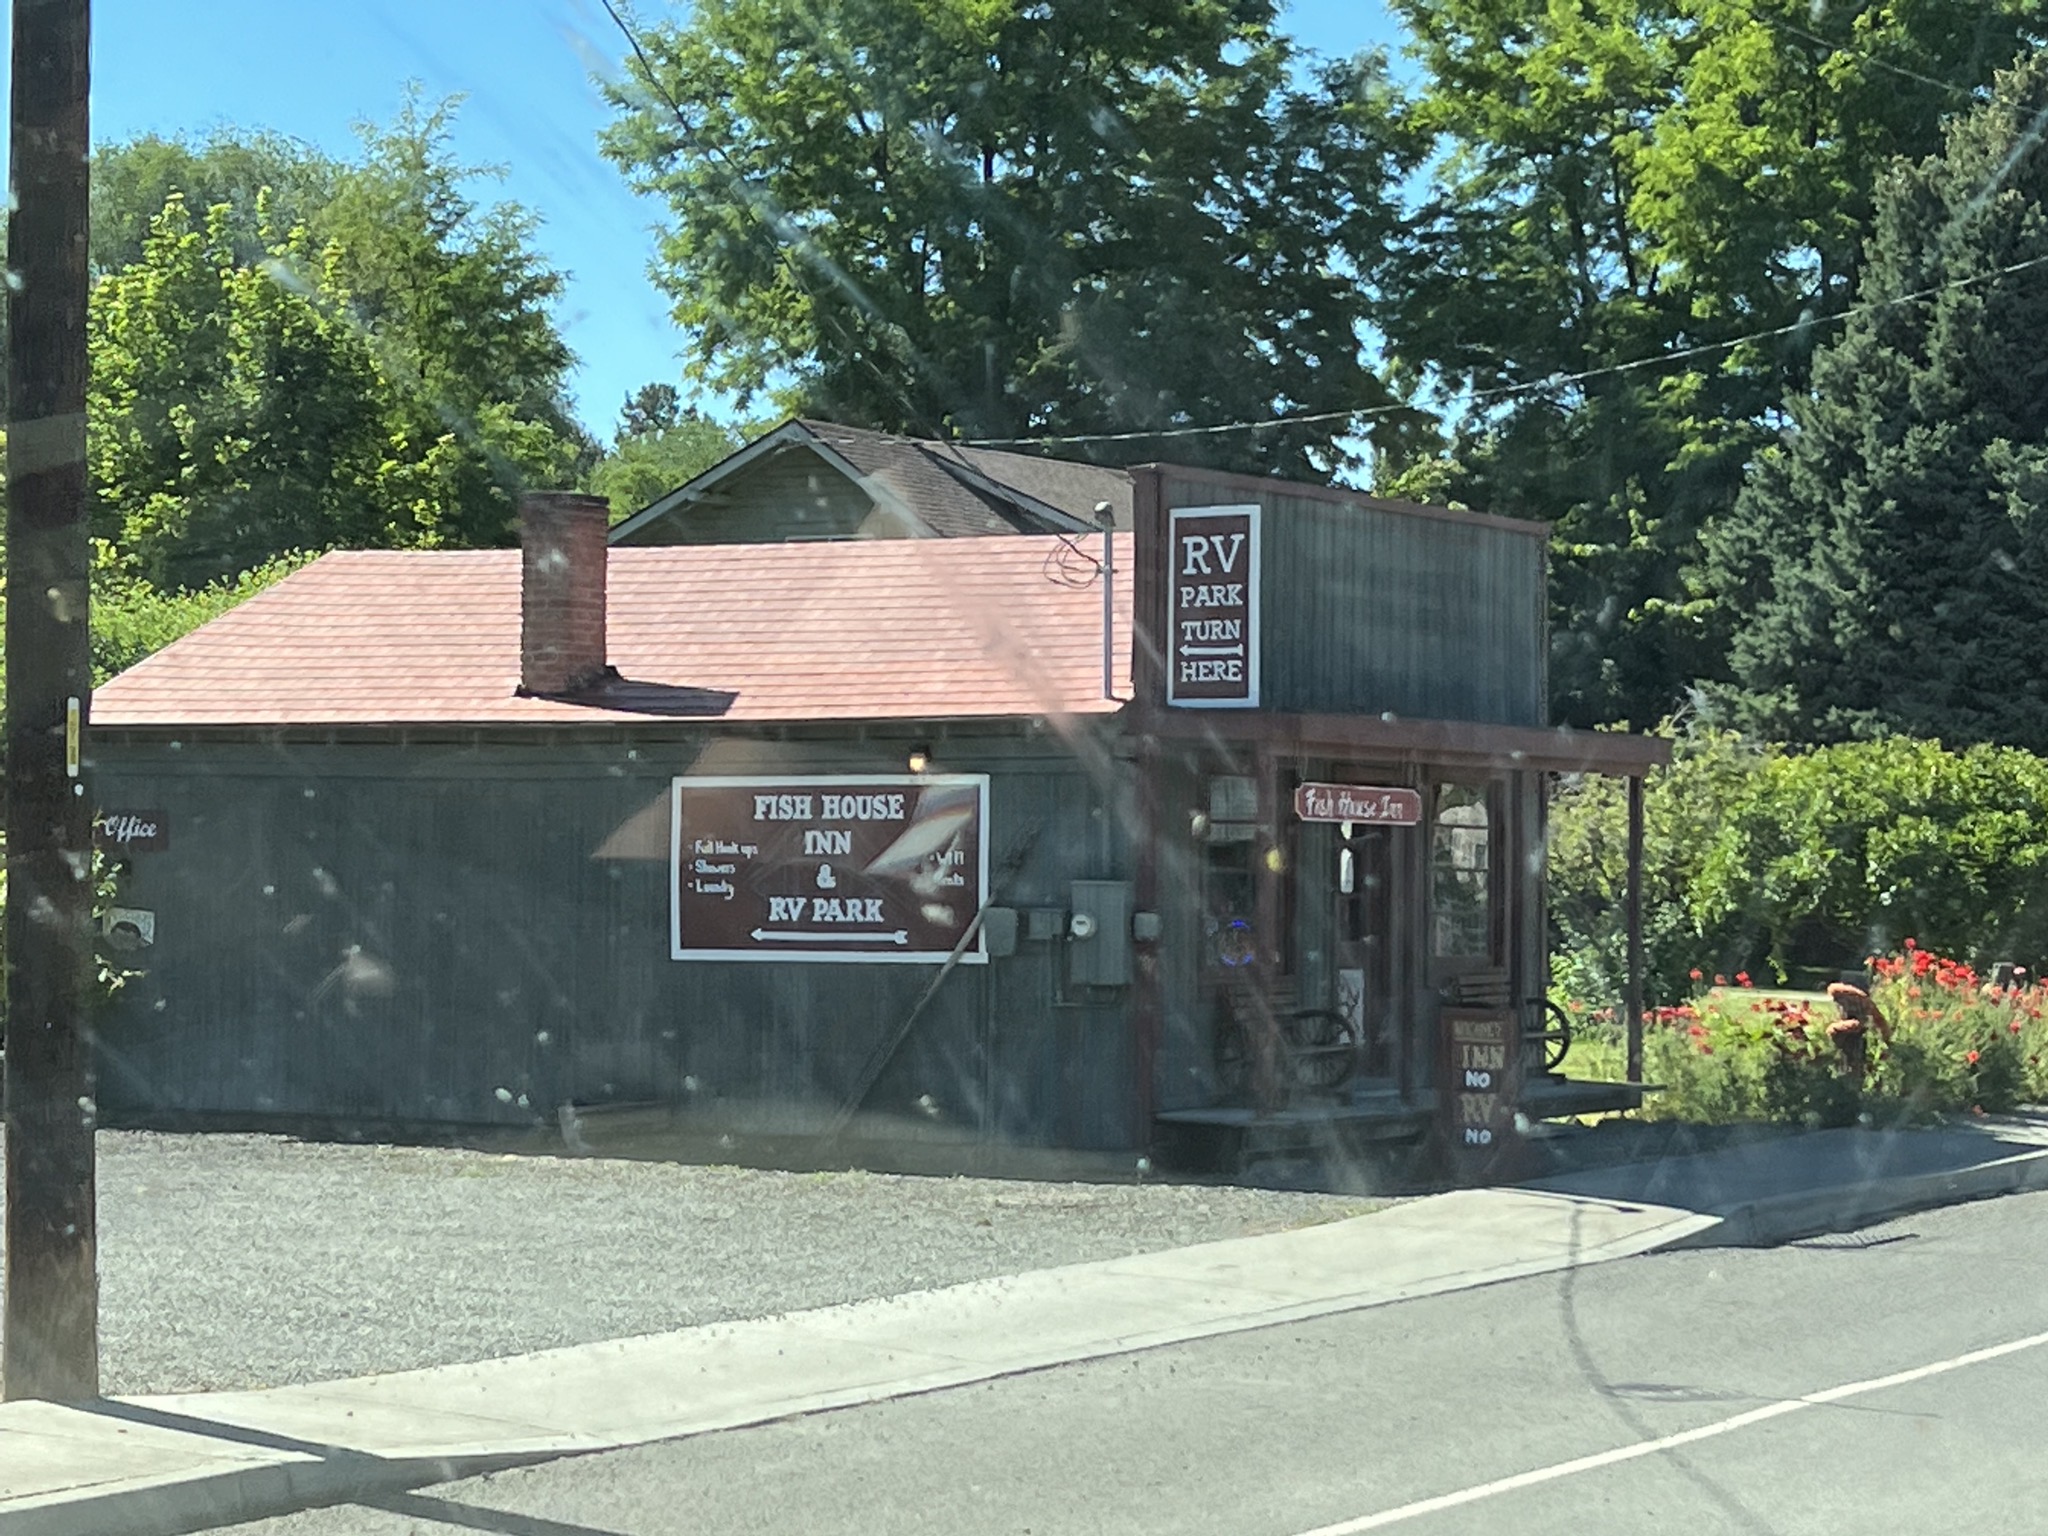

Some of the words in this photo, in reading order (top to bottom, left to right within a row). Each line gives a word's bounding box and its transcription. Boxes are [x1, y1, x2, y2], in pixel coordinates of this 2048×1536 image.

[1182, 533, 1245, 575] RV
[1180, 584, 1243, 608] PARK
[1181, 619, 1241, 641] TURN
[1180, 660, 1243, 682] HERE
[754, 795, 813, 821] FISH
[821, 794, 905, 820] HOUSE
[1379, 795, 1403, 819] Inn
[104, 815, 157, 842] Office
[804, 830, 852, 855] INN
[816, 864, 837, 889] &
[769, 897, 806, 922] RV
[812, 897, 885, 922] PARK
[1465, 1069, 1490, 1088] NO
[1460, 1093, 1497, 1123] RV
[1465, 1128, 1492, 1144] NO
